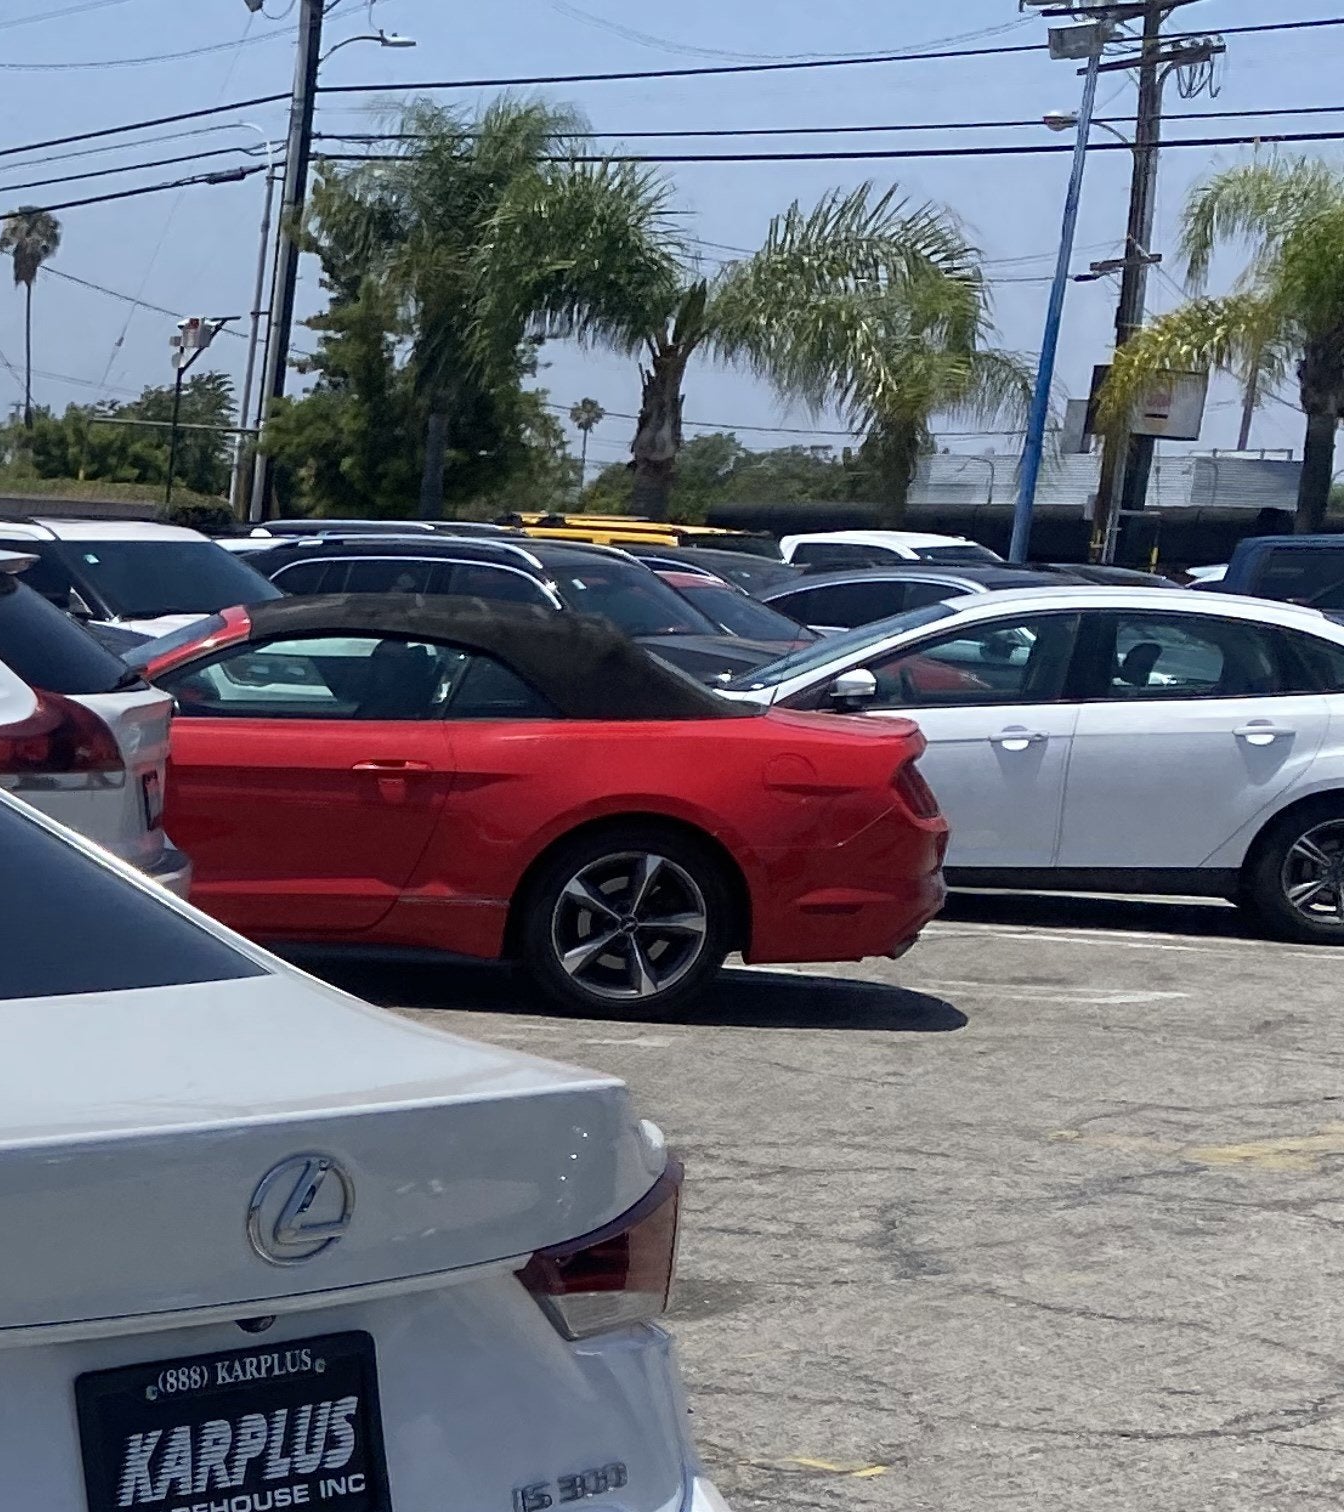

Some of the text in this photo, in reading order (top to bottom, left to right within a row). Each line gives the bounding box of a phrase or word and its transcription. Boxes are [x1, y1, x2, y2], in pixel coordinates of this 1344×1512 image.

[157, 1348, 312, 1393] (888) KARPLUS
[117, 1396, 359, 1507] KARPLUS
[319, 1472, 366, 1499] INC
